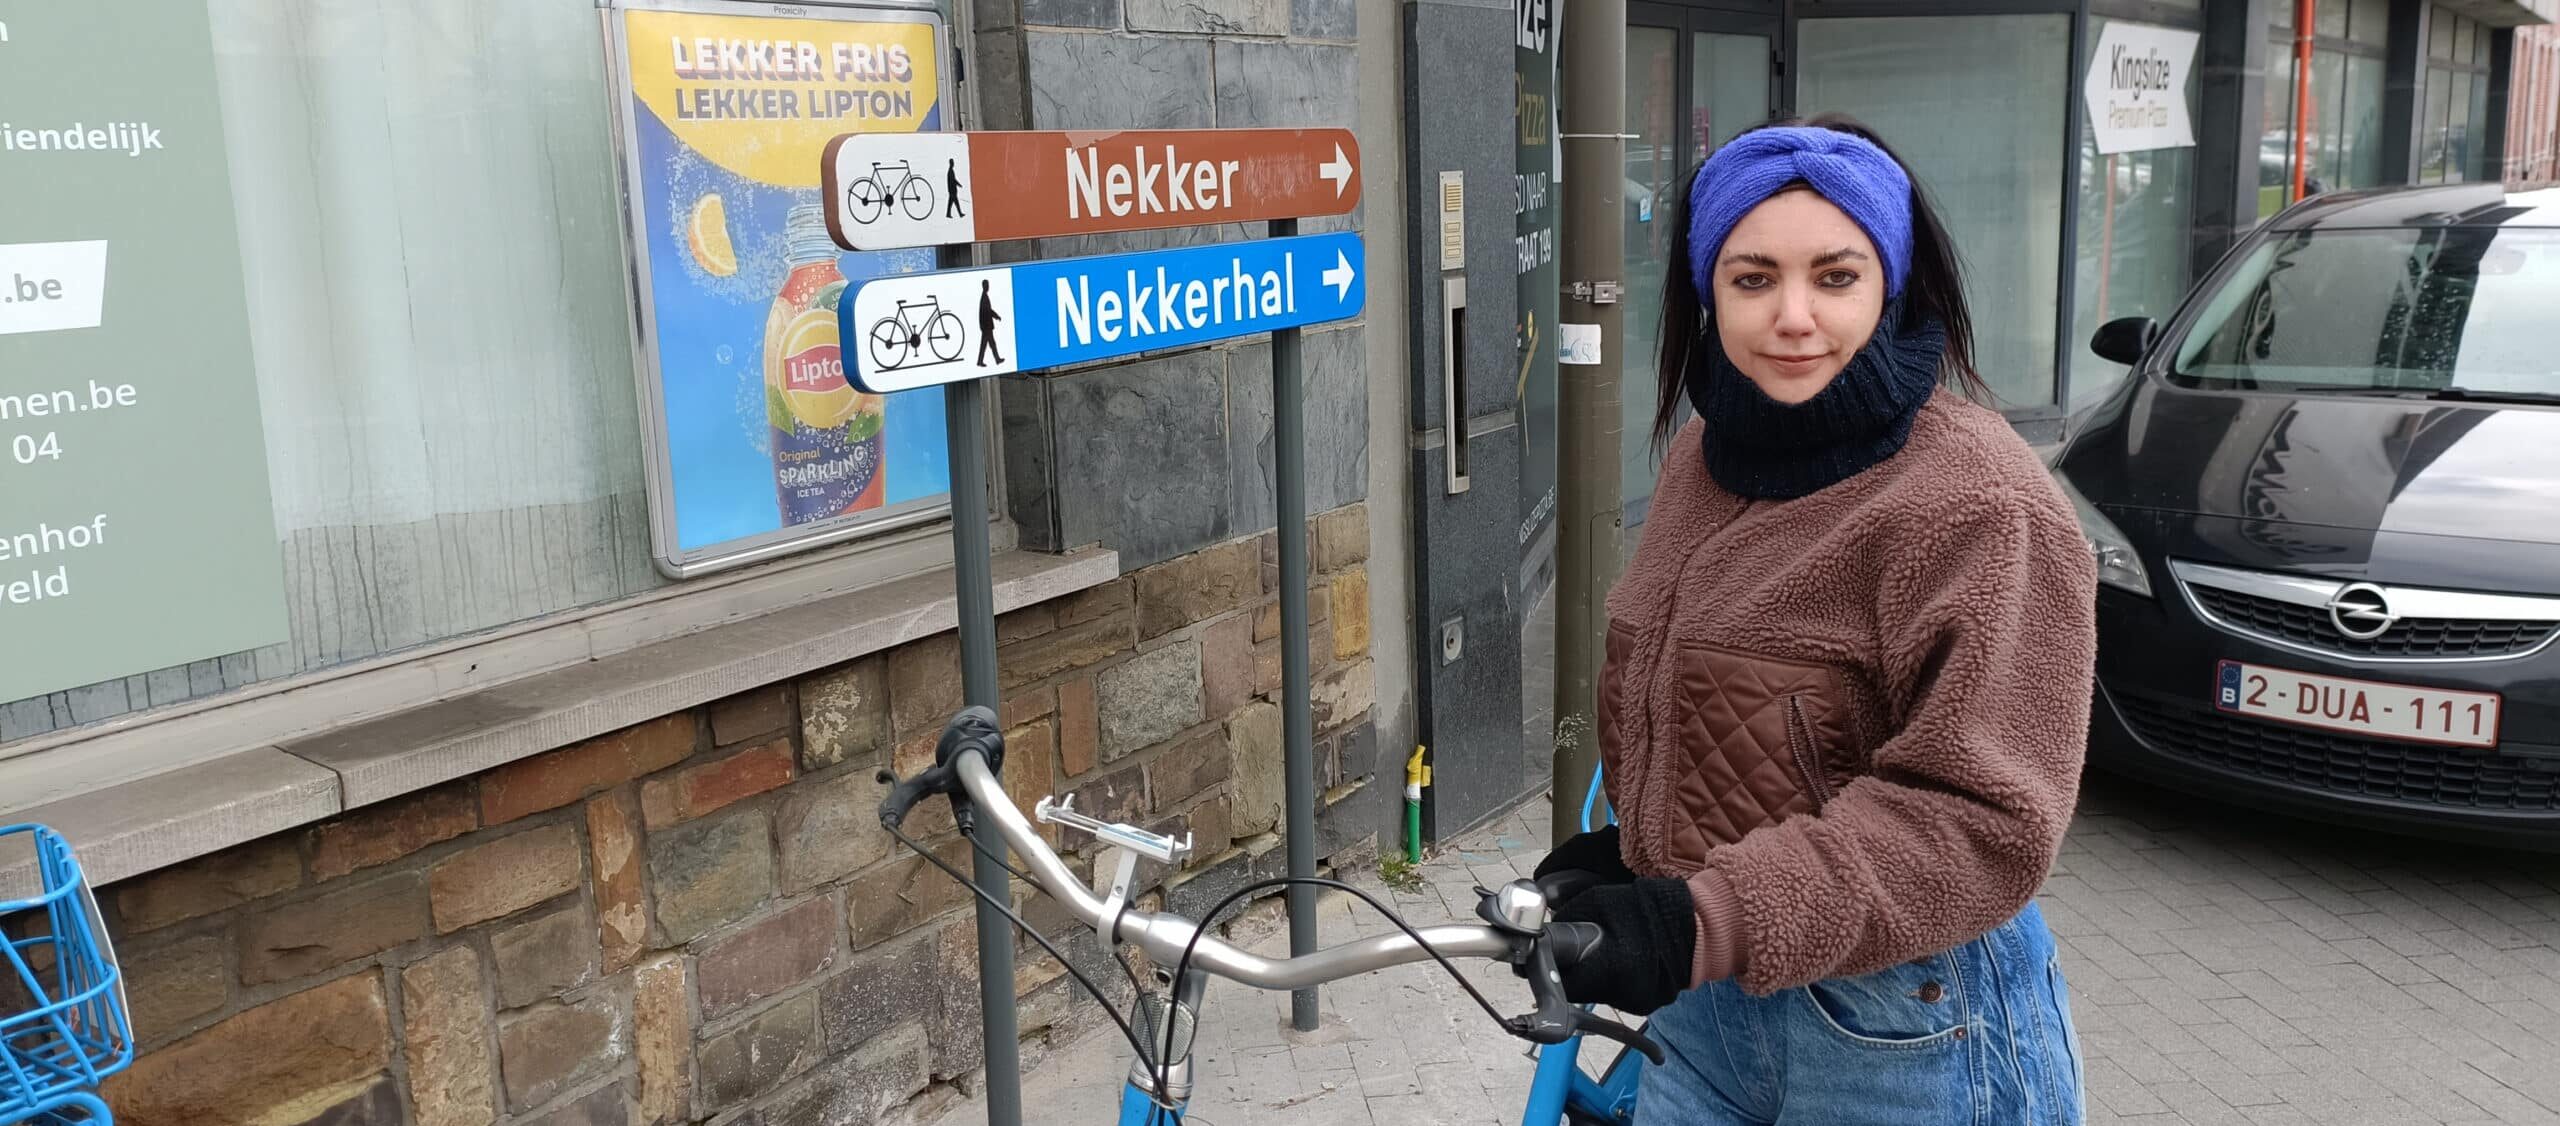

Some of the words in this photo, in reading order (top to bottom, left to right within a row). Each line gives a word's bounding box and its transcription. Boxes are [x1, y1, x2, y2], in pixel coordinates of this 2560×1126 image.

[671, 36, 823, 80] LEKKER
[831, 41, 912, 83] FRIS
[2110, 43, 2170, 101] Kingslize
[675, 88, 800, 119] LEKKER
[808, 88, 912, 119] LIPTON
[0, 122, 163, 157] iendelijk
[1066, 146, 1239, 219] Nekker
[1526, 171, 1547, 211] NAAR
[1056, 252, 1296, 349] Nekkerhal
[13, 432, 63, 464] 04
[780, 446, 821, 464] Original
[780, 446, 866, 486] SPARKLING
[797, 489, 810, 499] ICE
[811, 487, 825, 497] TEA
[0, 566, 69, 606] eld
[2222, 688, 2236, 703] B
